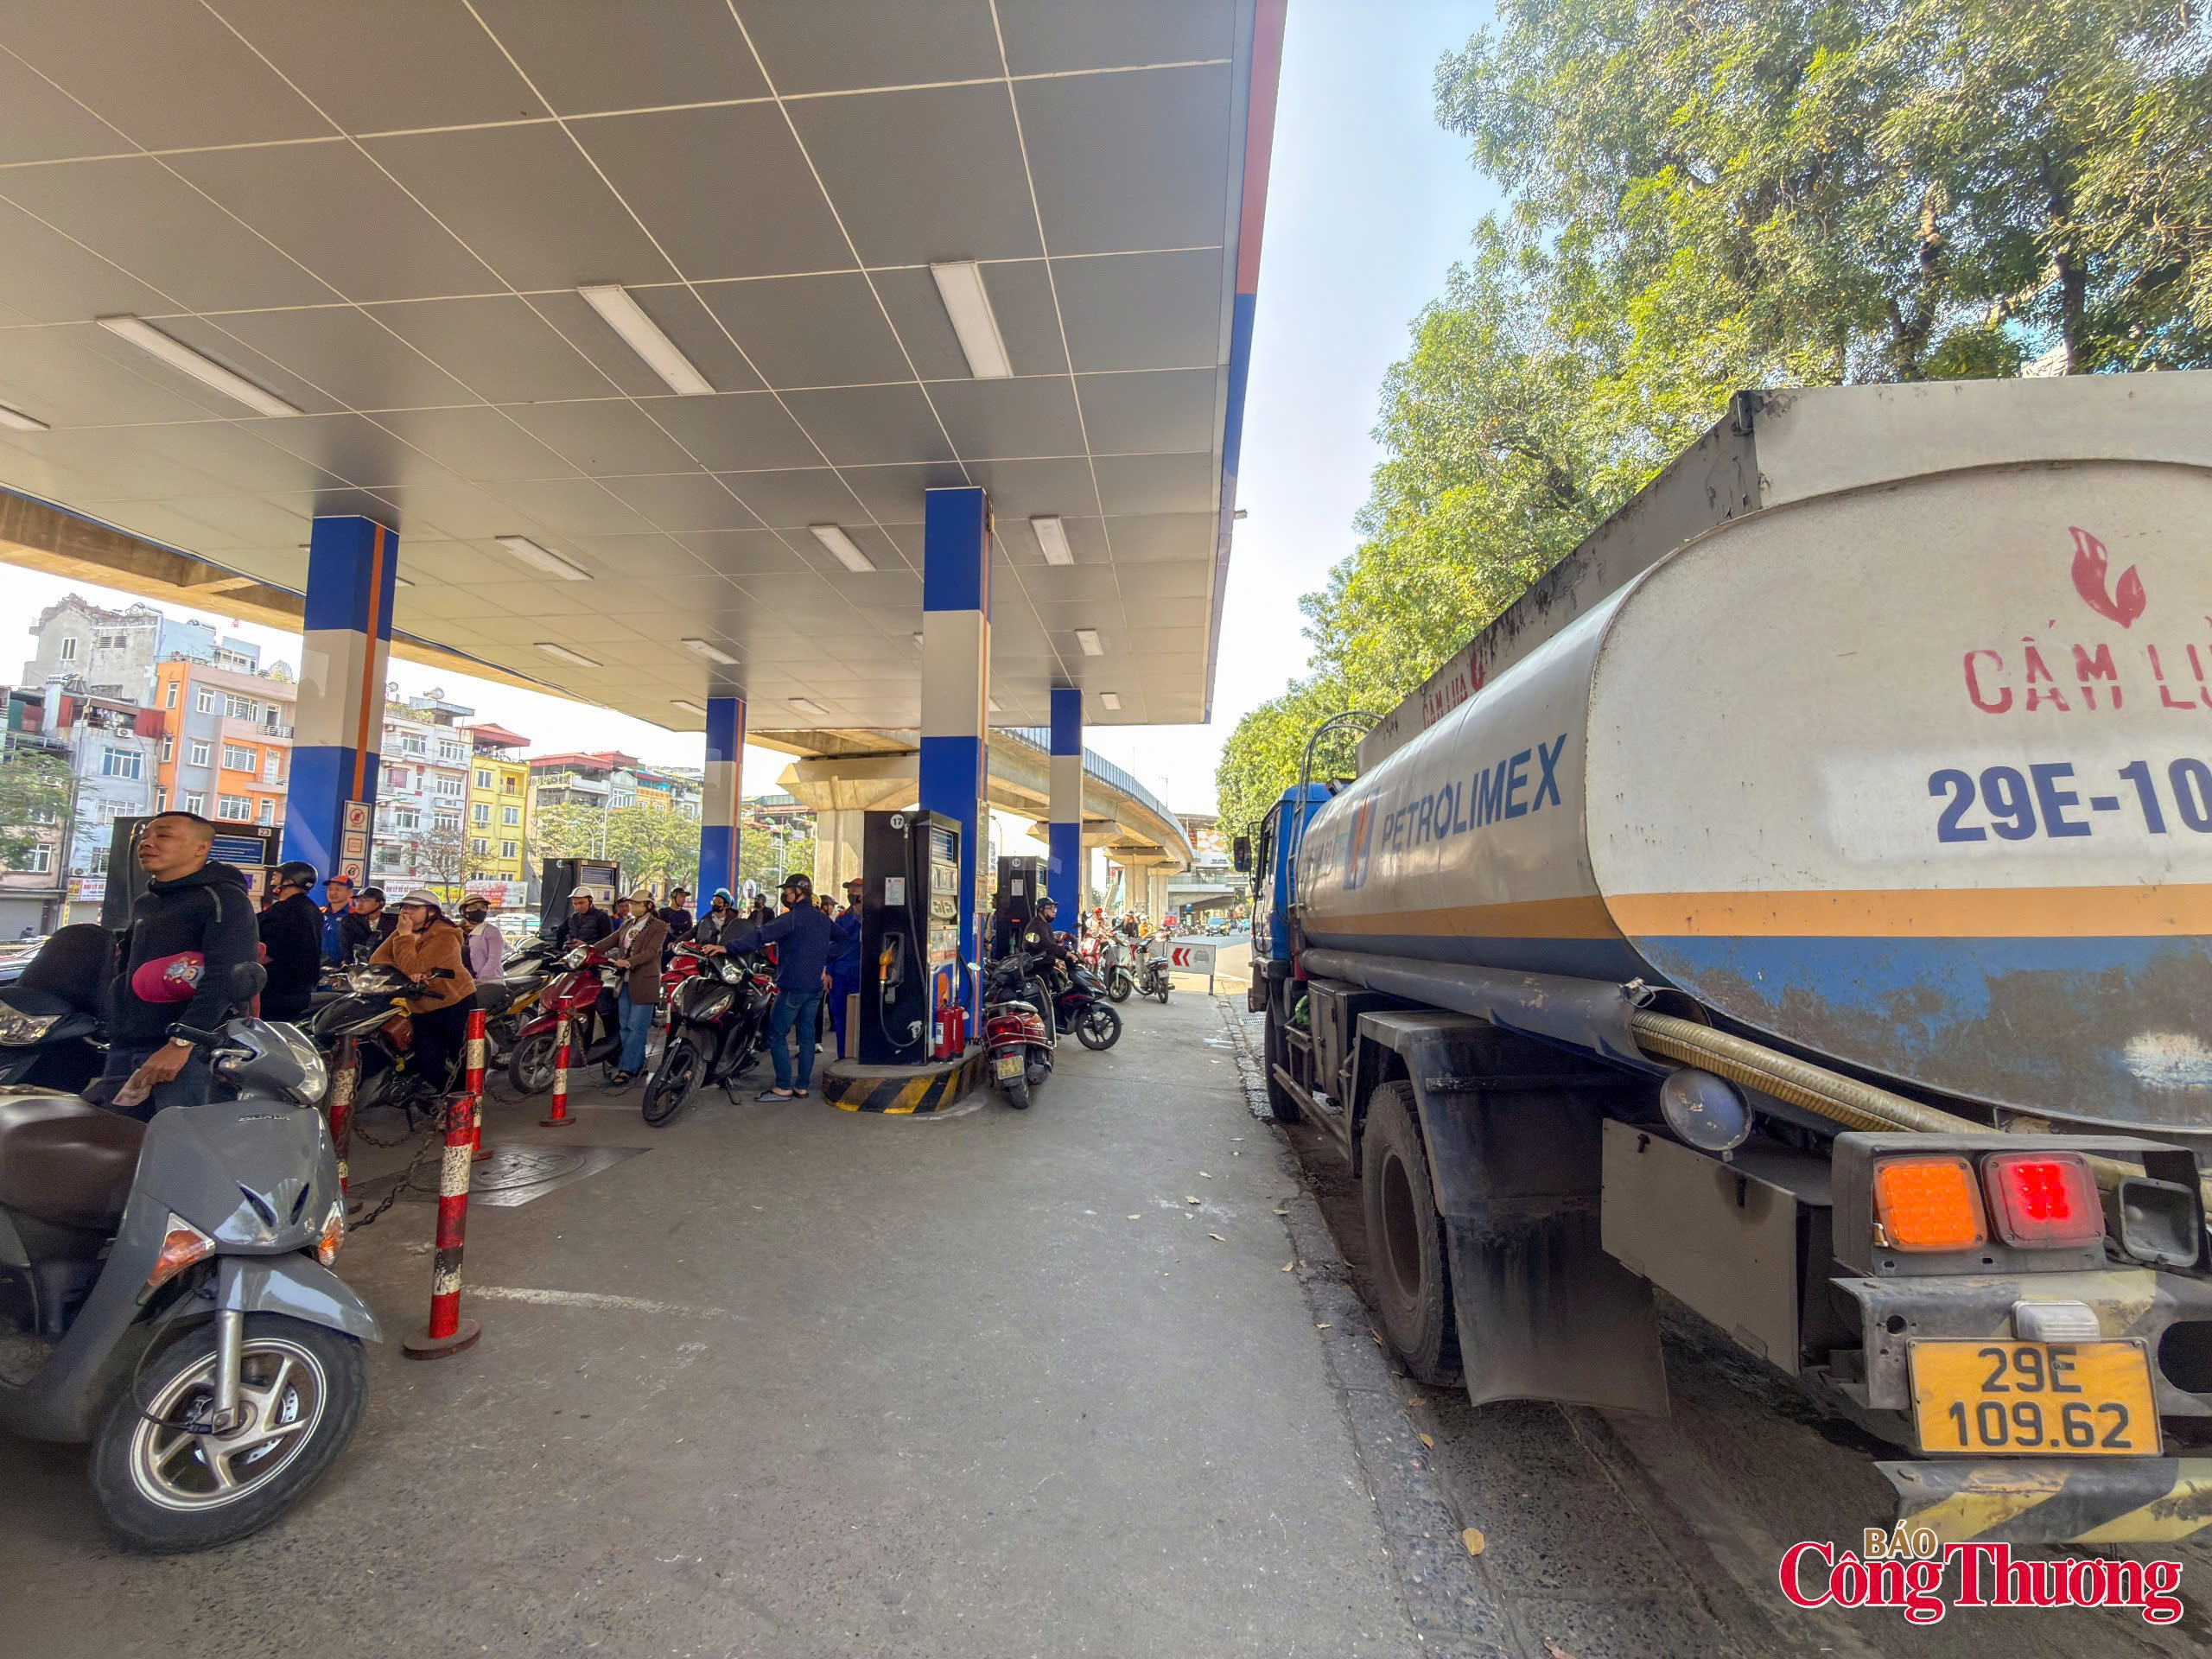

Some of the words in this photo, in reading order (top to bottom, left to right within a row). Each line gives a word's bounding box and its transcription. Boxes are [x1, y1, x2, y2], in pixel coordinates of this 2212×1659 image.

[1382, 733, 1567, 850] PETROLIMEX
[893, 817, 903, 826] 17
[1978, 1346, 2082, 1394] 29E
[1948, 1400, 2133, 1449] 109.62
